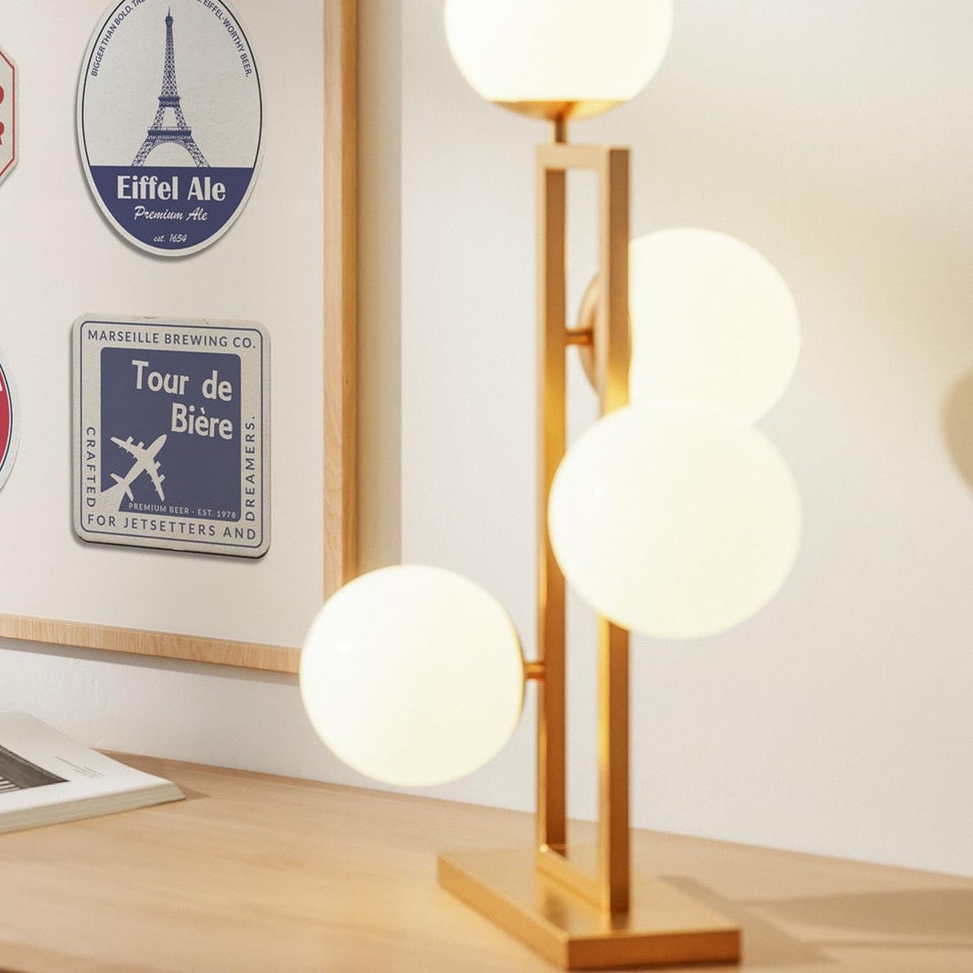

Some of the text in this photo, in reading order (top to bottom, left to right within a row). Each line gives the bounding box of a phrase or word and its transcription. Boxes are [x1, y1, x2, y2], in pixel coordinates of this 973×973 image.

[91, 46, 105, 76] BIGGER
[101, 24, 117, 46] THAN
[114, 5, 134, 25] BOLD.
[240, 53, 252, 77] BEER.
[117, 175, 226, 202] Eiffel Ale
[134, 205, 208, 221] Premium Ale
[170, 234, 187, 242] 1654
[88, 330, 256, 349] MARSEILLE BREWING CO.
[132, 360, 233, 401] Tour de
[171, 403, 233, 440] Bière
[86, 427, 96, 508] CRAFTED
[245, 416, 255, 521] DREAMERS.
[129, 503, 166, 512] PREMIUM
[88, 514, 256, 540] FOR JETSETTERS AND
